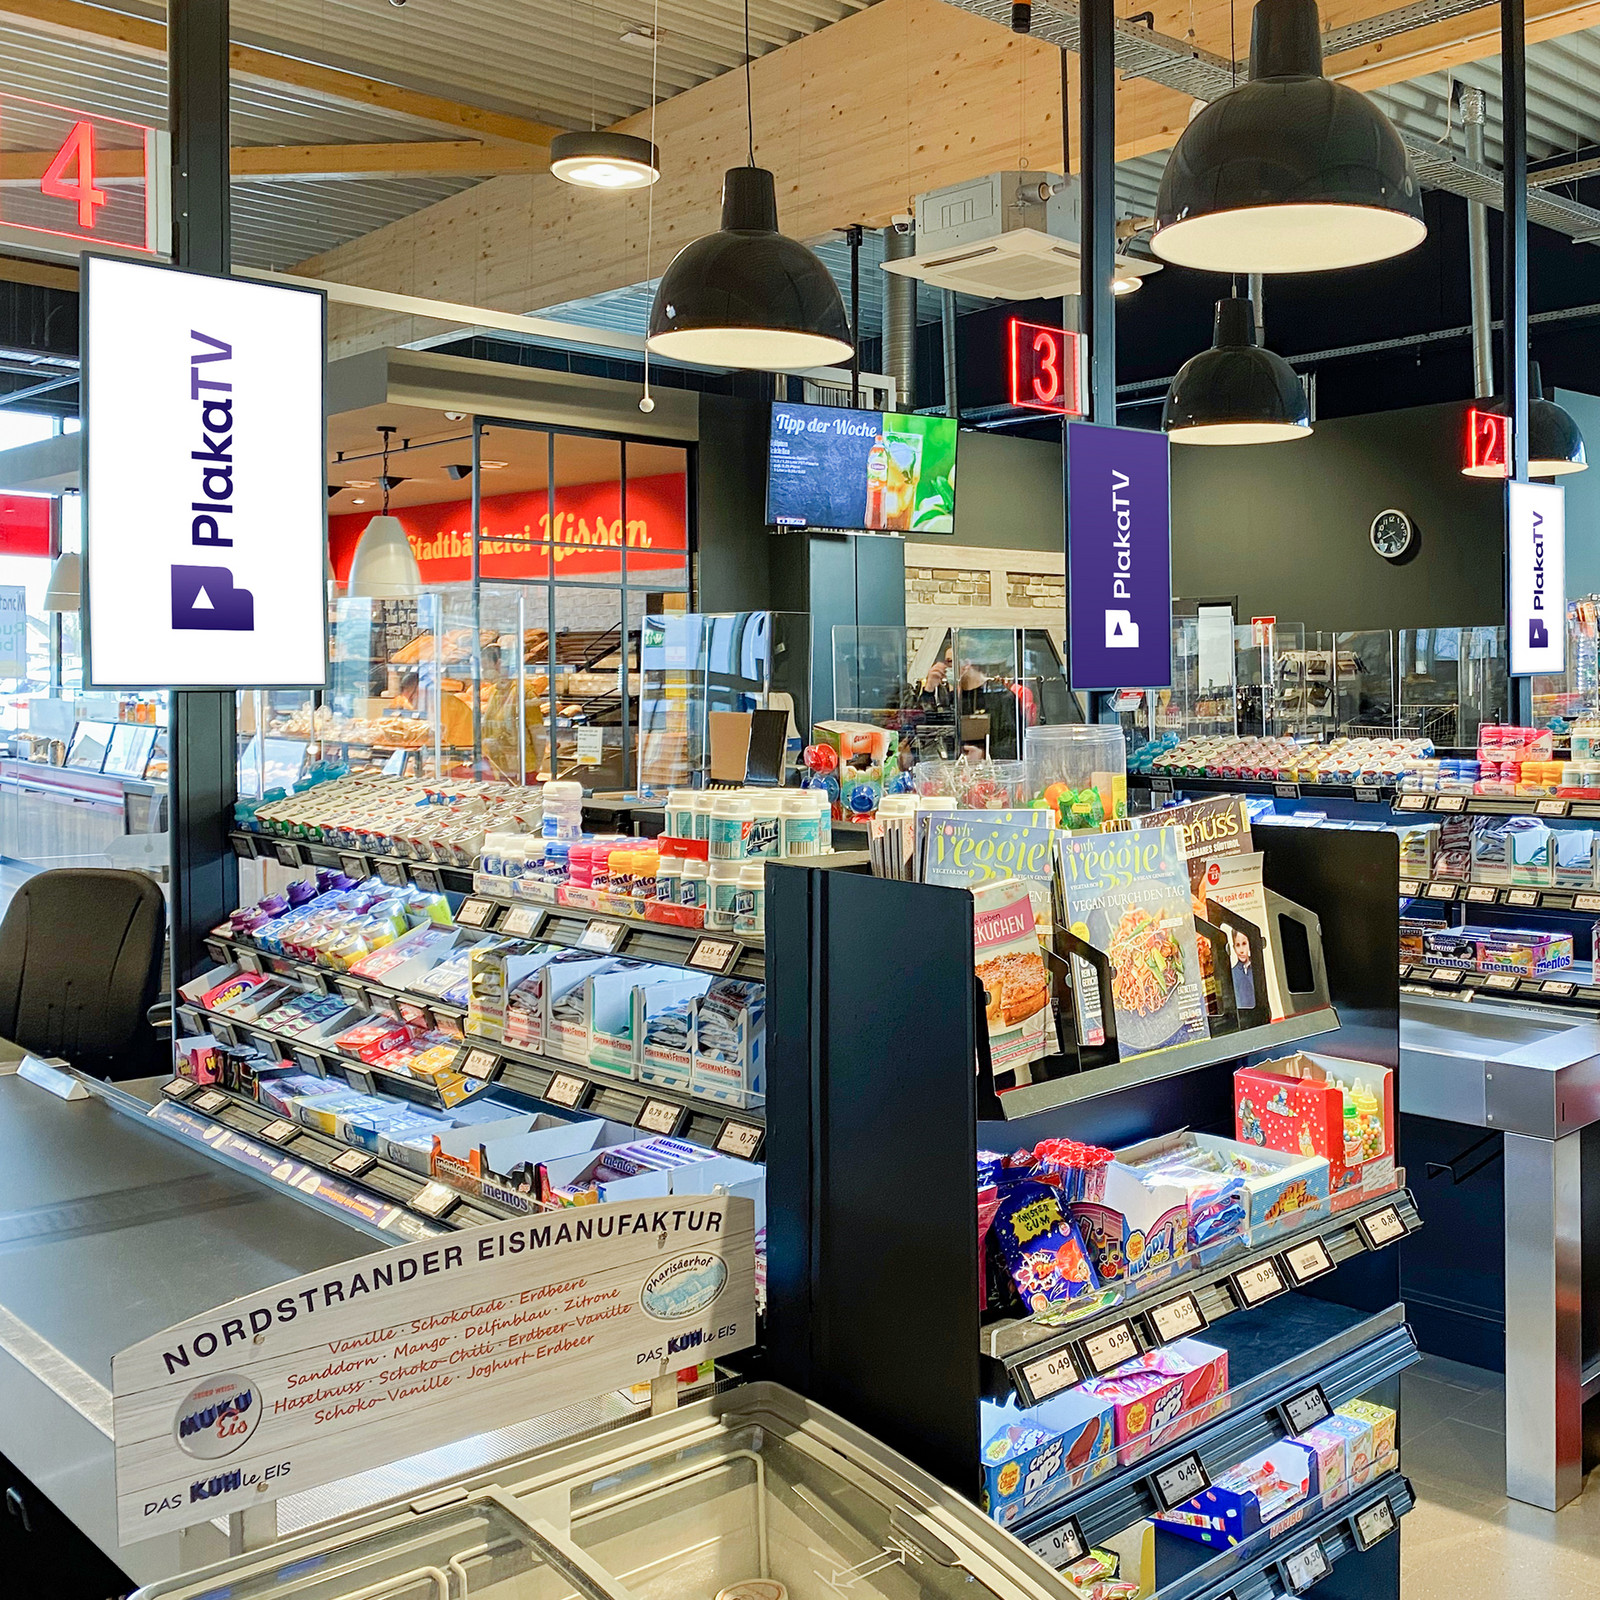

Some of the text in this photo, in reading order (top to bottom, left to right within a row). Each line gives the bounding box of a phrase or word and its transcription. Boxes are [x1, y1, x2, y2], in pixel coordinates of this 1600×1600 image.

[40, 120, 107, 229] 4
[1032, 332, 1059, 402] 3
[190, 328, 235, 548] PlakaTV
[775, 413, 877, 438] Tipp der Woche
[1482, 417, 1498, 467] 2
[408, 511, 652, 562] Stadtbäkerei Nissen
[1111, 469, 1132, 599] PlakaTV
[1532, 510, 1544, 610] PlakaTV
[1162, 813, 1239, 846] enuss
[1072, 885, 1185, 913] VEGAN DURCH DEN TAG
[700, 945, 715, 955] 1,19
[1427, 956, 1471, 968] mentos
[1537, 954, 1571, 973] mentos
[1481, 962, 1528, 975] mentos
[672, 1052, 690, 1064] FRIEND
[723, 1066, 742, 1078] FRIEND
[739, 1132, 758, 1145] 0,79
[603, 1154, 637, 1175] mentos
[483, 1181, 528, 1212] mentos
[1381, 1213, 1397, 1228] 0,89
[646, 1255, 714, 1295] Pharisäerhof
[1256, 1267, 1275, 1283] 0,99
[161, 1210, 724, 1375] NORDSTRANDER EISMANUFAKTUR
[328, 1277, 588, 1355] Vanille Schokolade Erdbeere
[1174, 1303, 1194, 1320] 0,59
[286, 1288, 620, 1390] Sanddorn Mango Delfinblau Zitrone
[636, 1347, 663, 1365] DAS
[717, 1323, 737, 1339] EIS
[1108, 1330, 1130, 1349] 0,99
[273, 1303, 633, 1415] Haselnuss Schoko-Chili Erdbeer-Vanille
[1047, 1356, 1070, 1376] 0,49
[313, 1333, 596, 1425] Schoko-Vanille Joghurt-Erdbeer
[1149, 1389, 1184, 1447] DIPS
[1304, 1394, 1321, 1411] 1,19
[215, 1408, 248, 1439] Eis
[1029, 1437, 1064, 1472] CRAZY
[1023, 1447, 1064, 1508] DIPS
[1177, 1464, 1197, 1482] 0,49
[144, 1494, 182, 1517] DAS
[264, 1461, 291, 1481] EIS
[1269, 1508, 1304, 1540] HARIBO
[1373, 1506, 1389, 1522] 0,69
[1052, 1529, 1075, 1549] 0,49
[1303, 1549, 1321, 1567] 0,50
